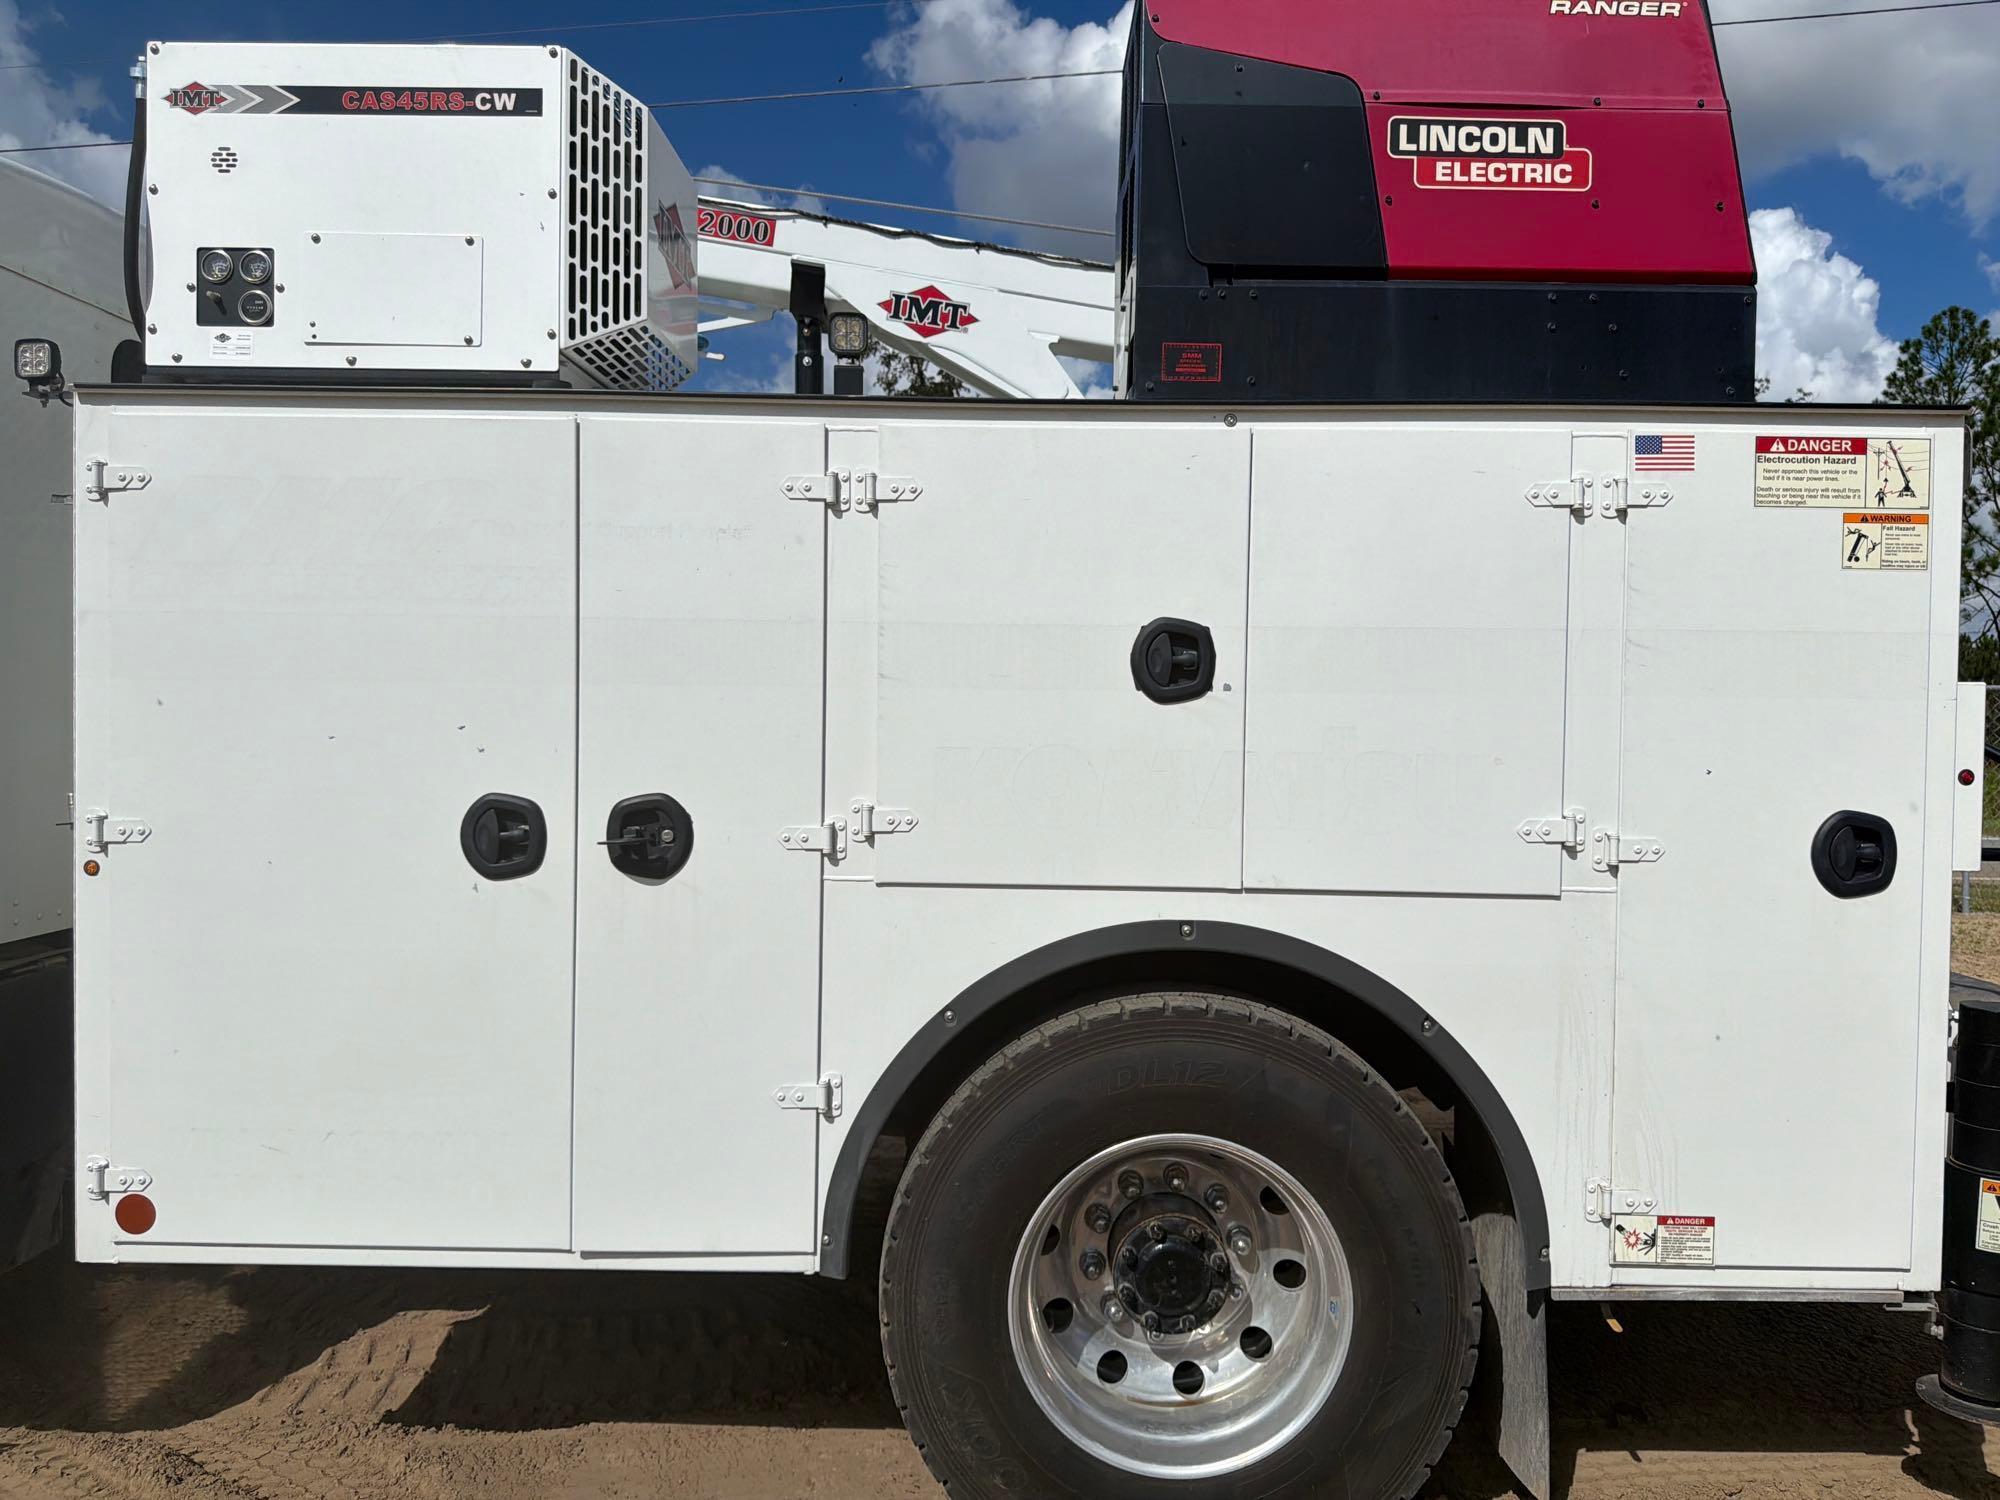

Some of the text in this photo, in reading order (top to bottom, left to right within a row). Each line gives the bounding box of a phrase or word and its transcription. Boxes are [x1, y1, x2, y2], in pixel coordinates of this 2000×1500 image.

[1549, 0, 1681, 17] RANGER
[169, 88, 222, 108] IMT
[342, 90, 517, 111] CAS45RS-CW
[1399, 123, 1555, 155] LINCOLN
[1435, 161, 1573, 184] ELECTRIC
[698, 210, 771, 244] 2000
[886, 290, 970, 332] IMT
[1787, 439, 1852, 452] DANGER
[1757, 455, 1857, 465] Electrocution Hazard
[1870, 515, 1911, 523] WARNING
[1674, 1217, 1705, 1225] DANGER
